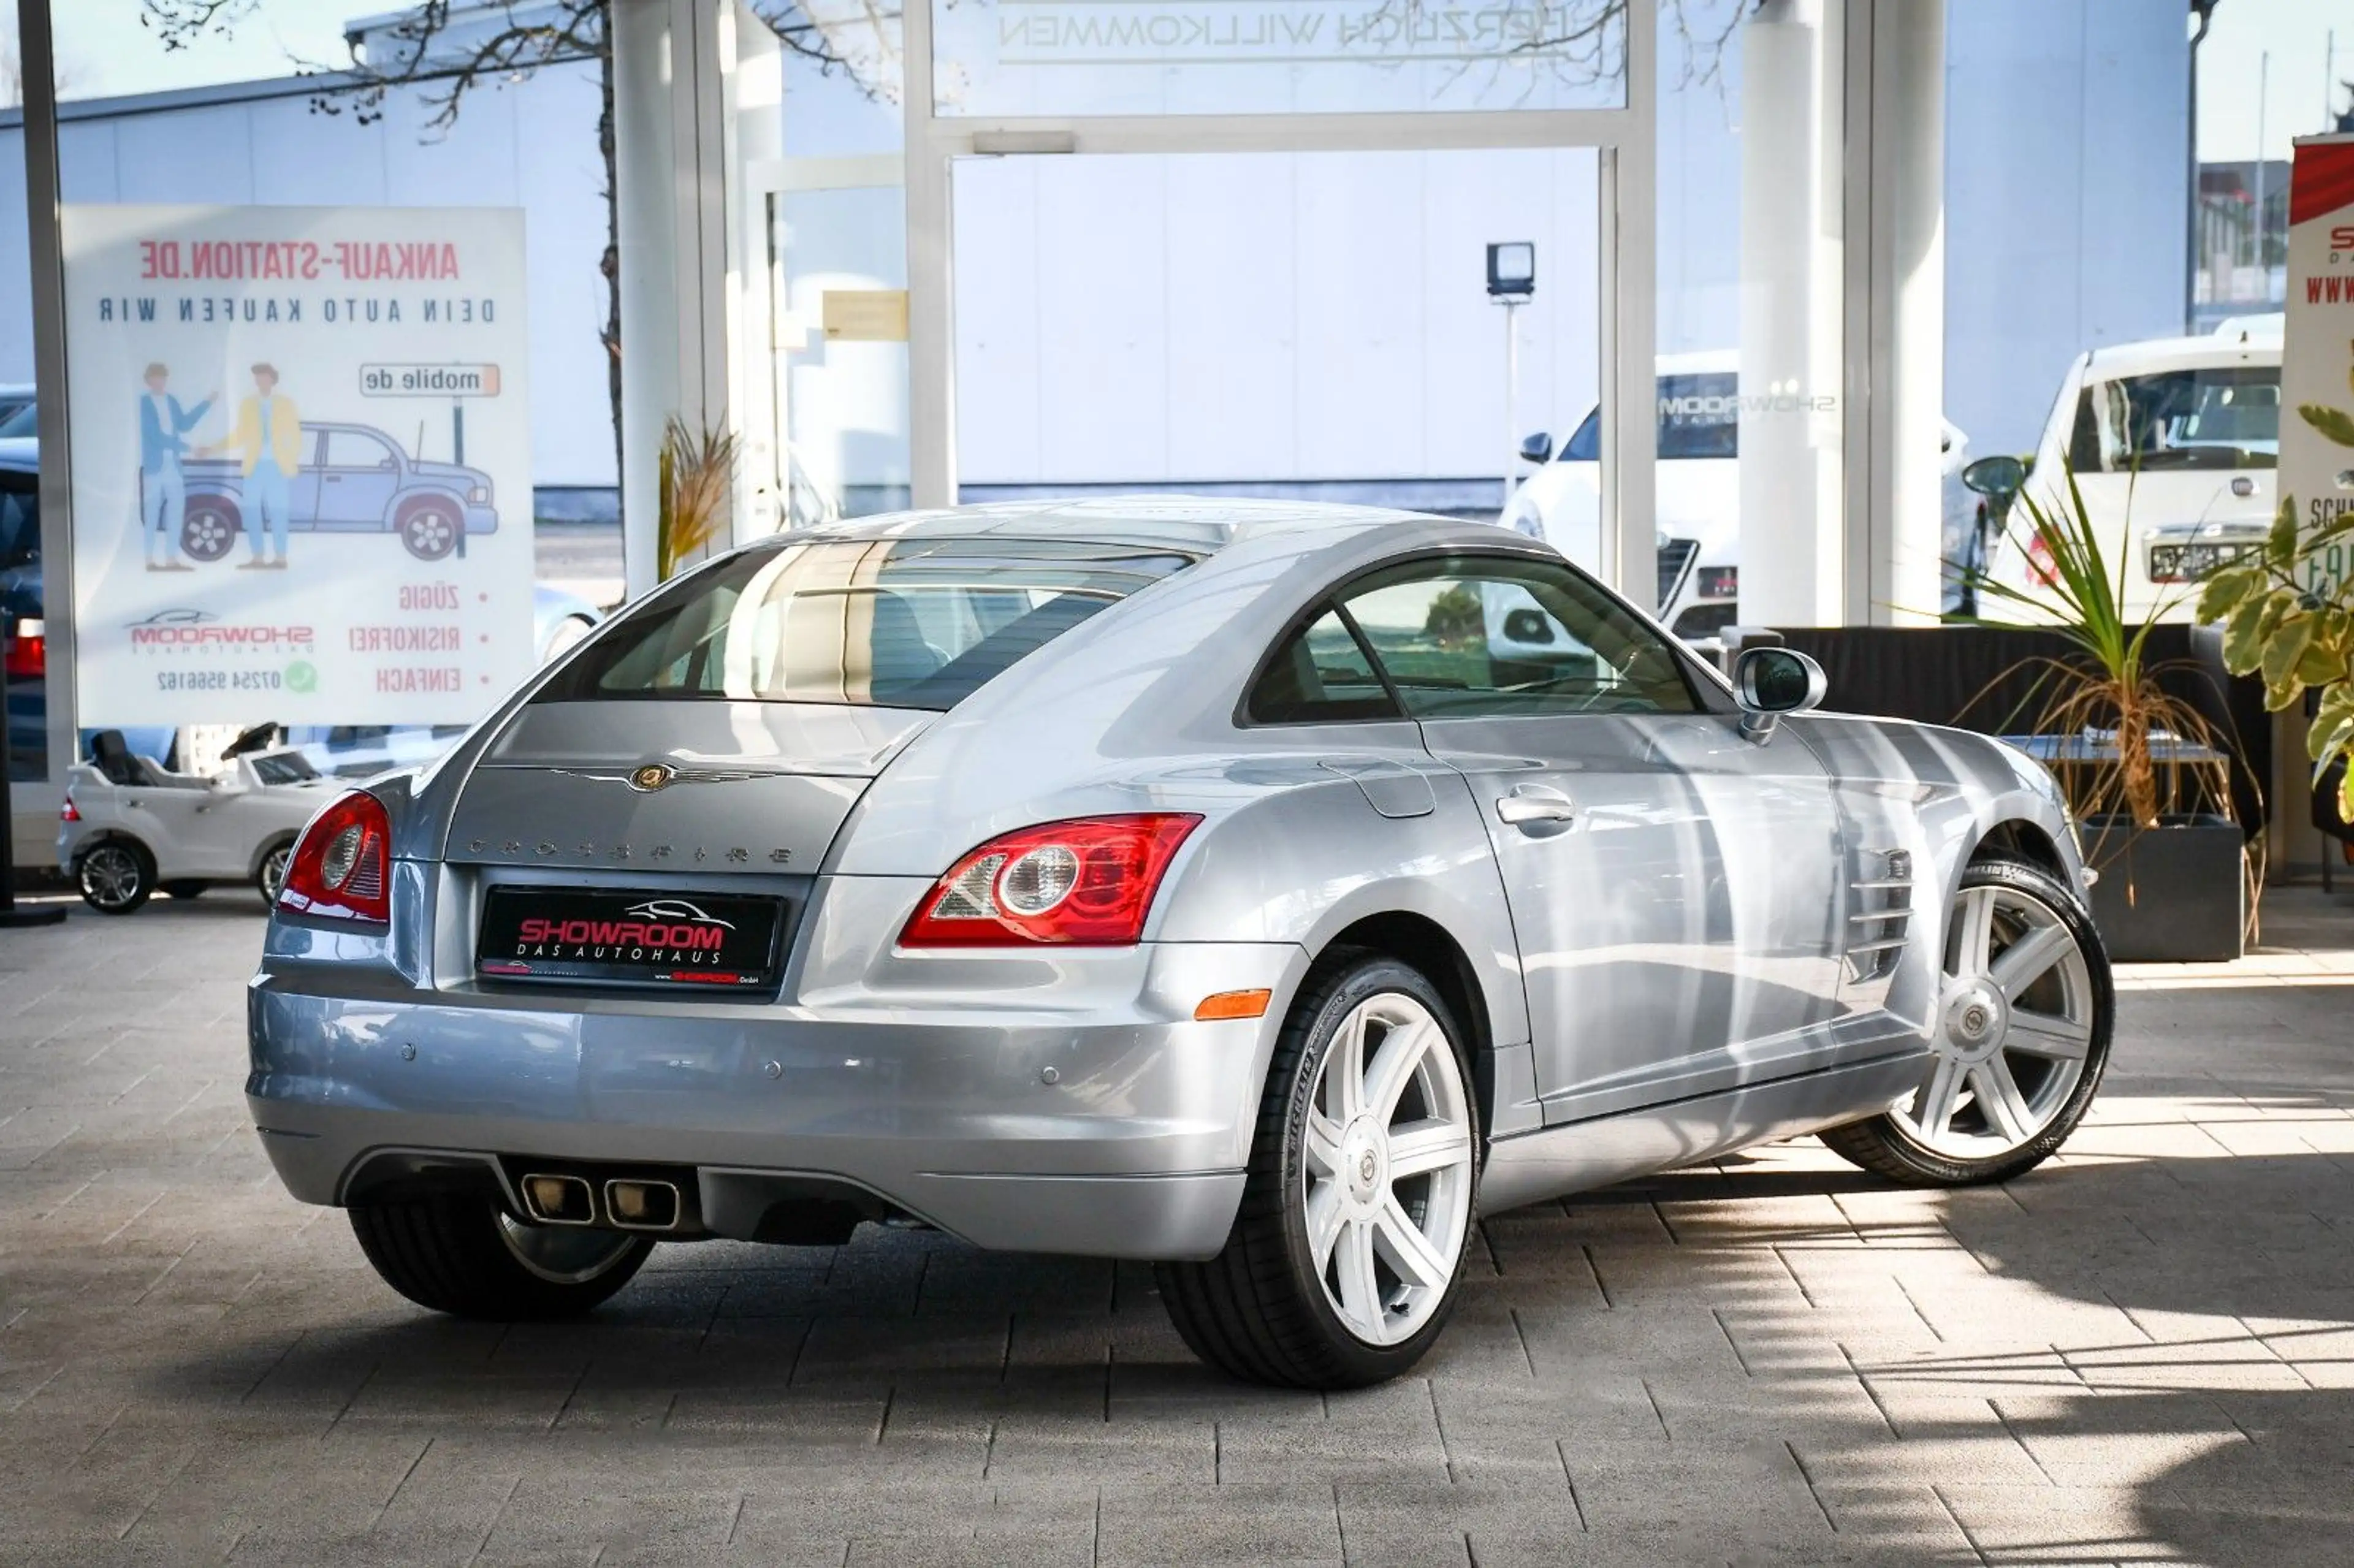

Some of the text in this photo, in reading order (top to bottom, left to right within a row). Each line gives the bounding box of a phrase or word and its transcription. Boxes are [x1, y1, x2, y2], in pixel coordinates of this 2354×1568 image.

[469, 838, 792, 863] CROSSFIRE
[519, 918, 724, 950] SHOWROOM
[516, 943, 722, 965] DAS AUTOHAUS
